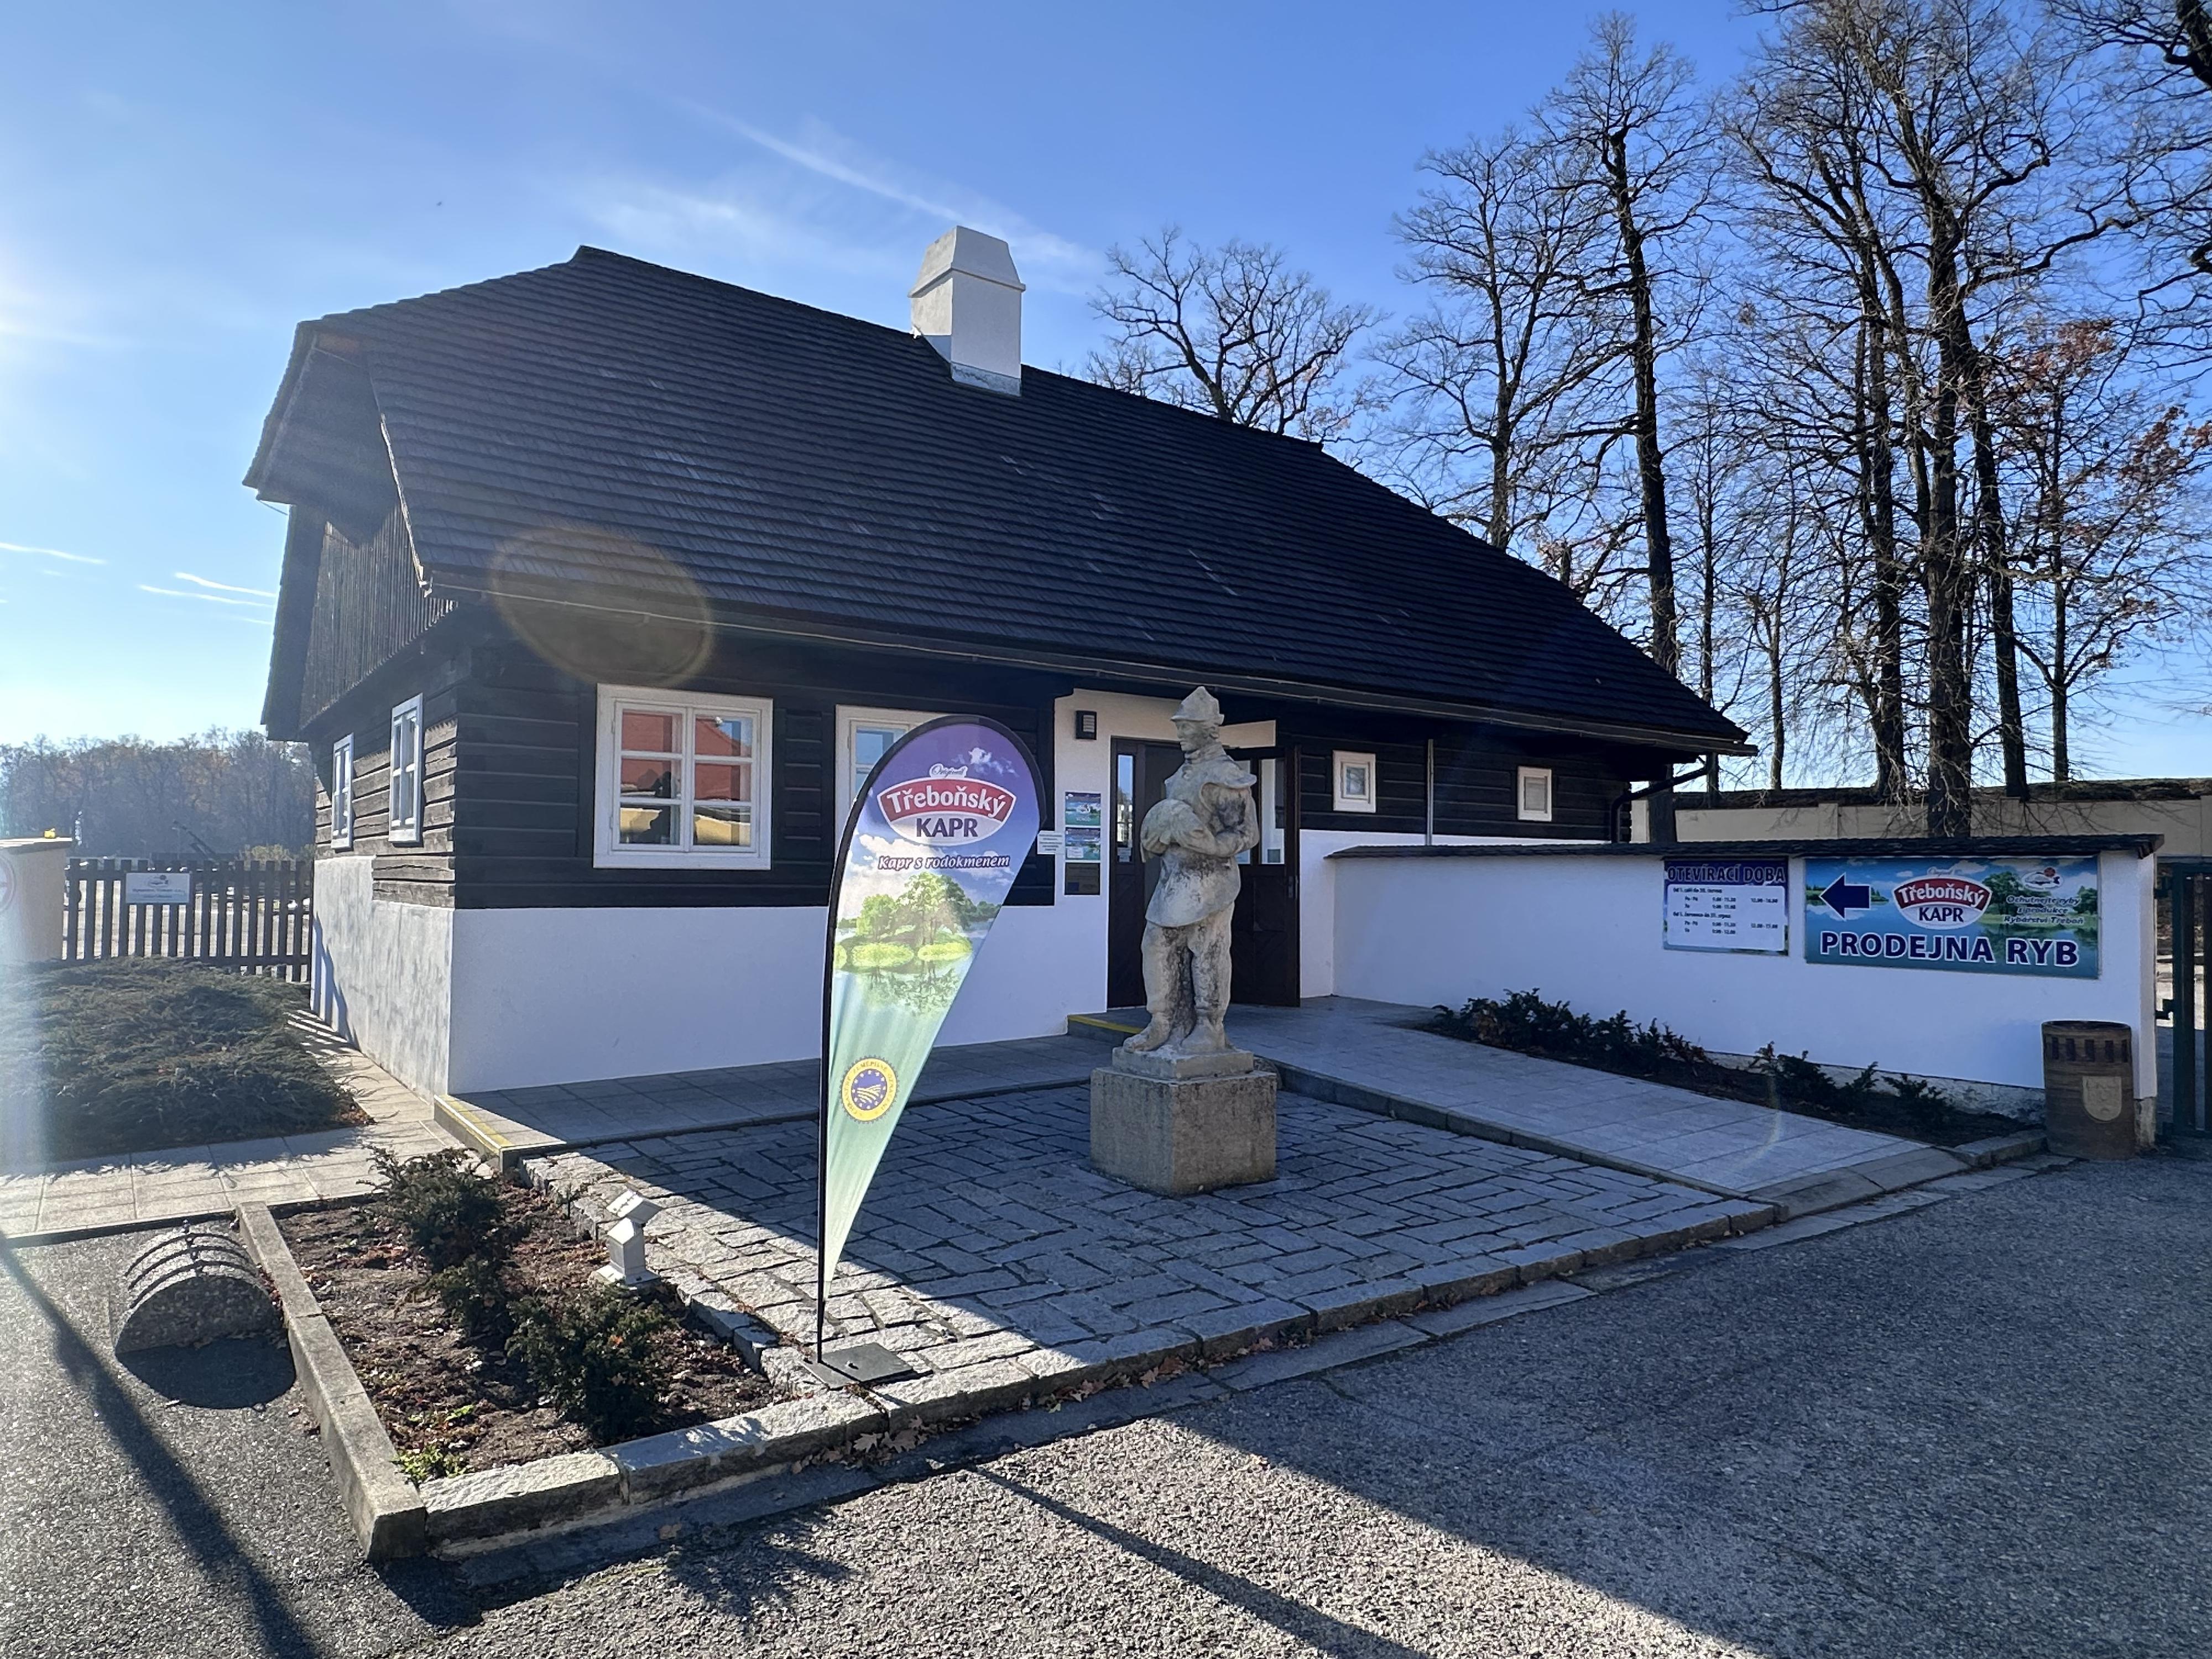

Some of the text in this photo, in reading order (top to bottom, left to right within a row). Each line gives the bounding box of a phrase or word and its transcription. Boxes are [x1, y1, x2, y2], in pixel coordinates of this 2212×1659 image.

[886, 785, 1006, 817] Třeboňský
[916, 817, 978, 837] KAPR
[878, 855, 1010, 872] Kapr s rodokmenem
[1667, 864, 1786, 883] OTEVÍRACÍ DOBA
[1898, 883, 1984, 907] Třeboňský
[1919, 906, 1964, 922] KAPR
[1820, 931, 2080, 968] PRODEJNA RYB
